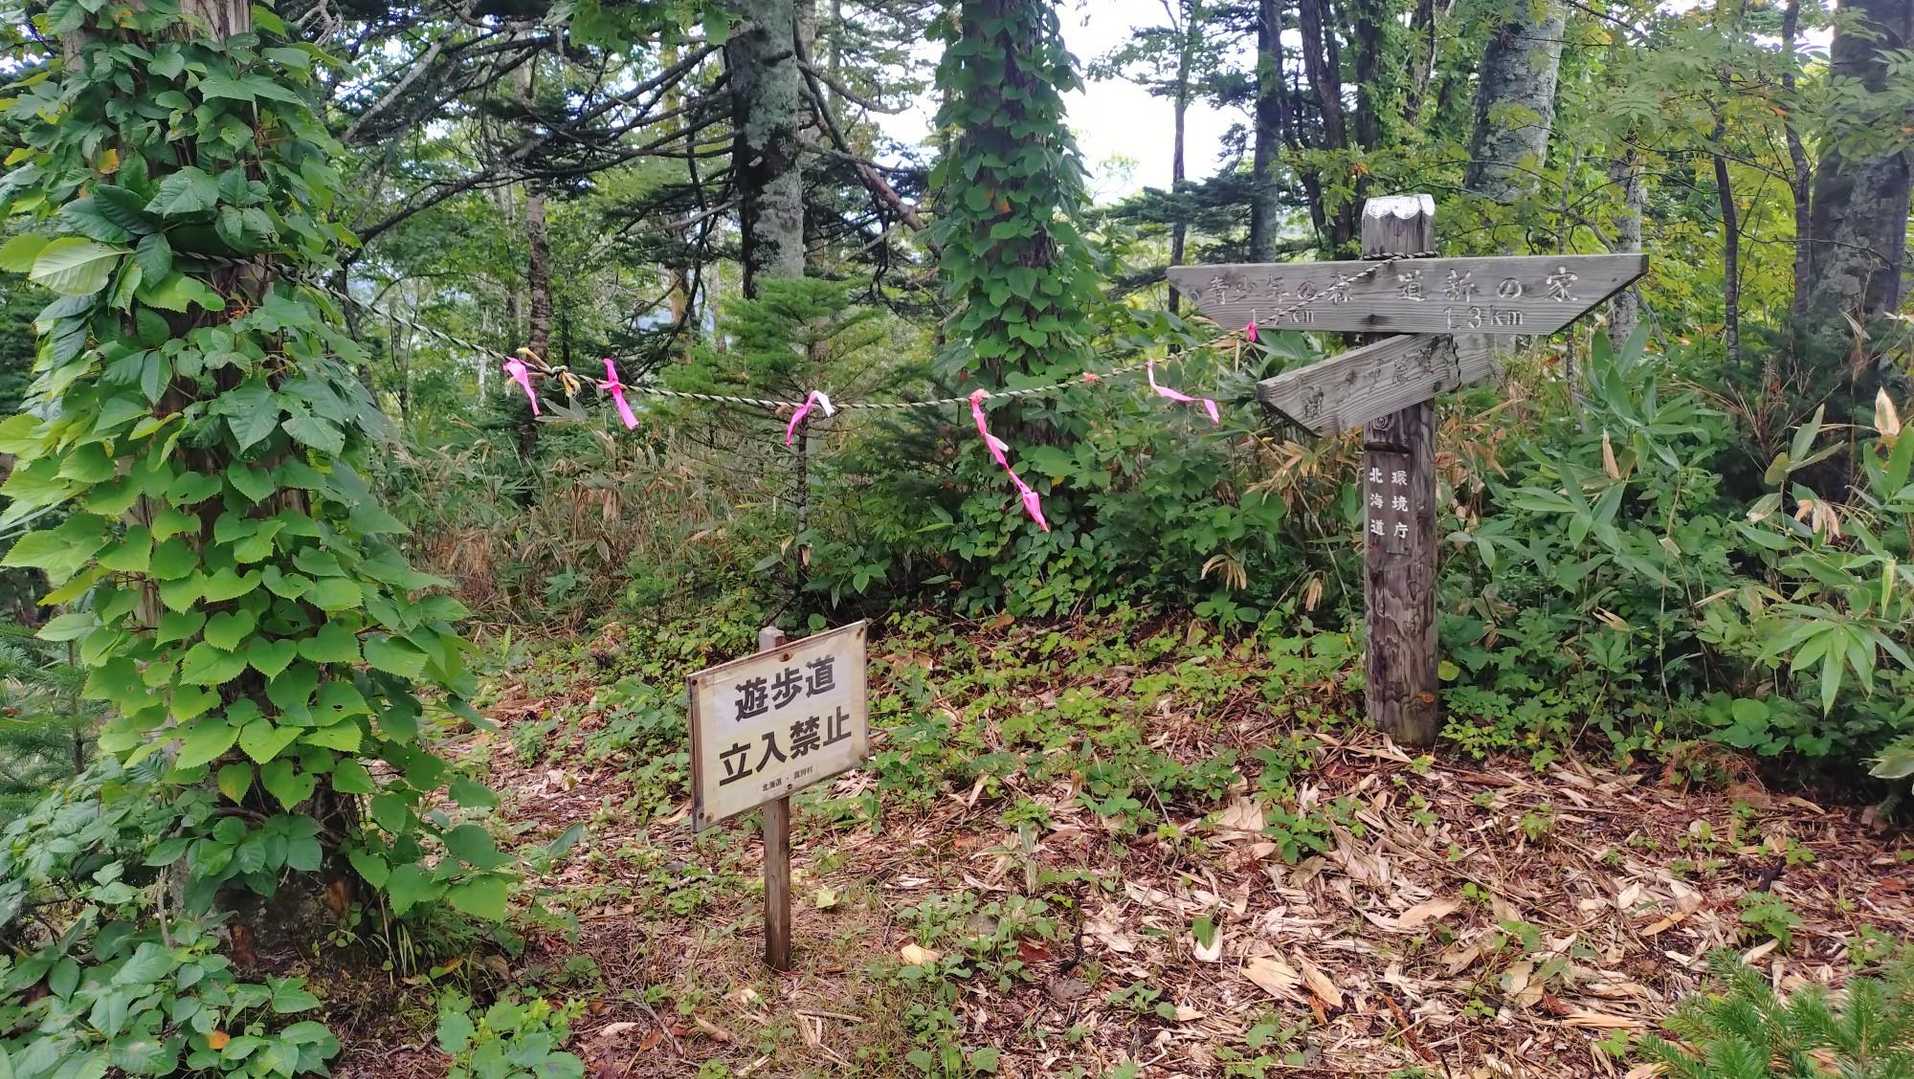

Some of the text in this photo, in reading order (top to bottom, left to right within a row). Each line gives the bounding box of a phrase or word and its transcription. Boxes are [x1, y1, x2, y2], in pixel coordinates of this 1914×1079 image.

[1396, 266, 1579, 302] 道新の家
[1369, 467, 1385, 536] 北海道
[1391, 470, 1409, 539] 環境庁
[735, 655, 836, 722] 遊歩道
[719, 705, 852, 786] 立入禁止
